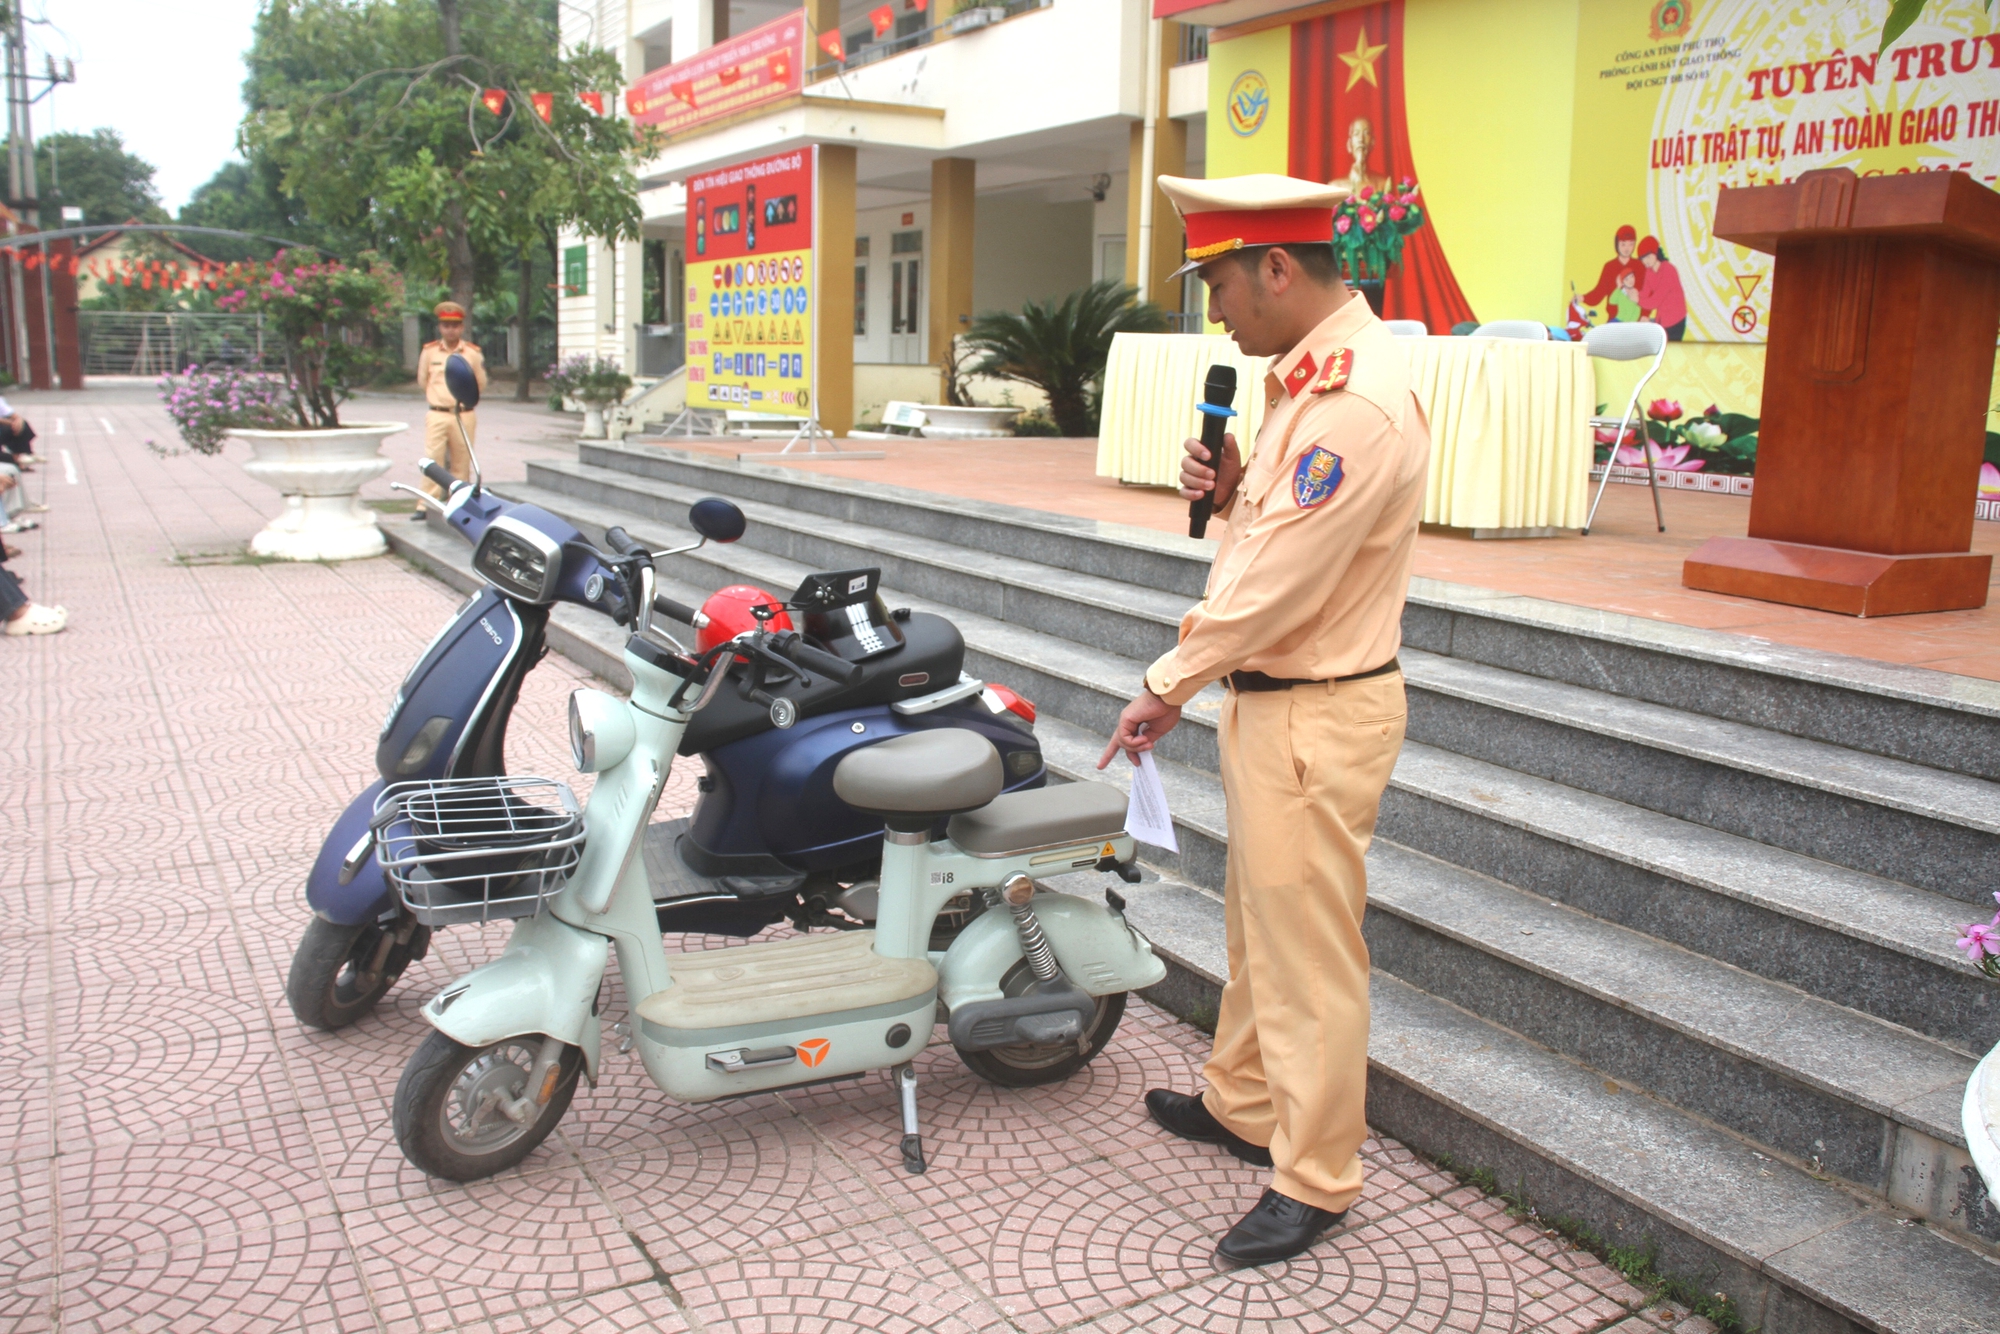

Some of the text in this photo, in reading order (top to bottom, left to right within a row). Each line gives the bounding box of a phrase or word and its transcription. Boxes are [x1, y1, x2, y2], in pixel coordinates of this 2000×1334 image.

[1600, 66, 1630, 79] PHÒNG
[1679, 53, 1705, 67] GIAO
[1707, 47, 1742, 62] THÔNG
[1615, 51, 1641, 63] CÔNG
[1644, 49, 1655, 58] AN
[1644, 75, 1668, 88] CSGT
[1748, 48, 1879, 101] TUYÊN
[1651, 99, 2000, 174] LUẬT TRẬT TỰ, AN TOÀN GIAO TH
[1296, 474, 1331, 494] CSGT
[942, 871, 955, 884] i8
